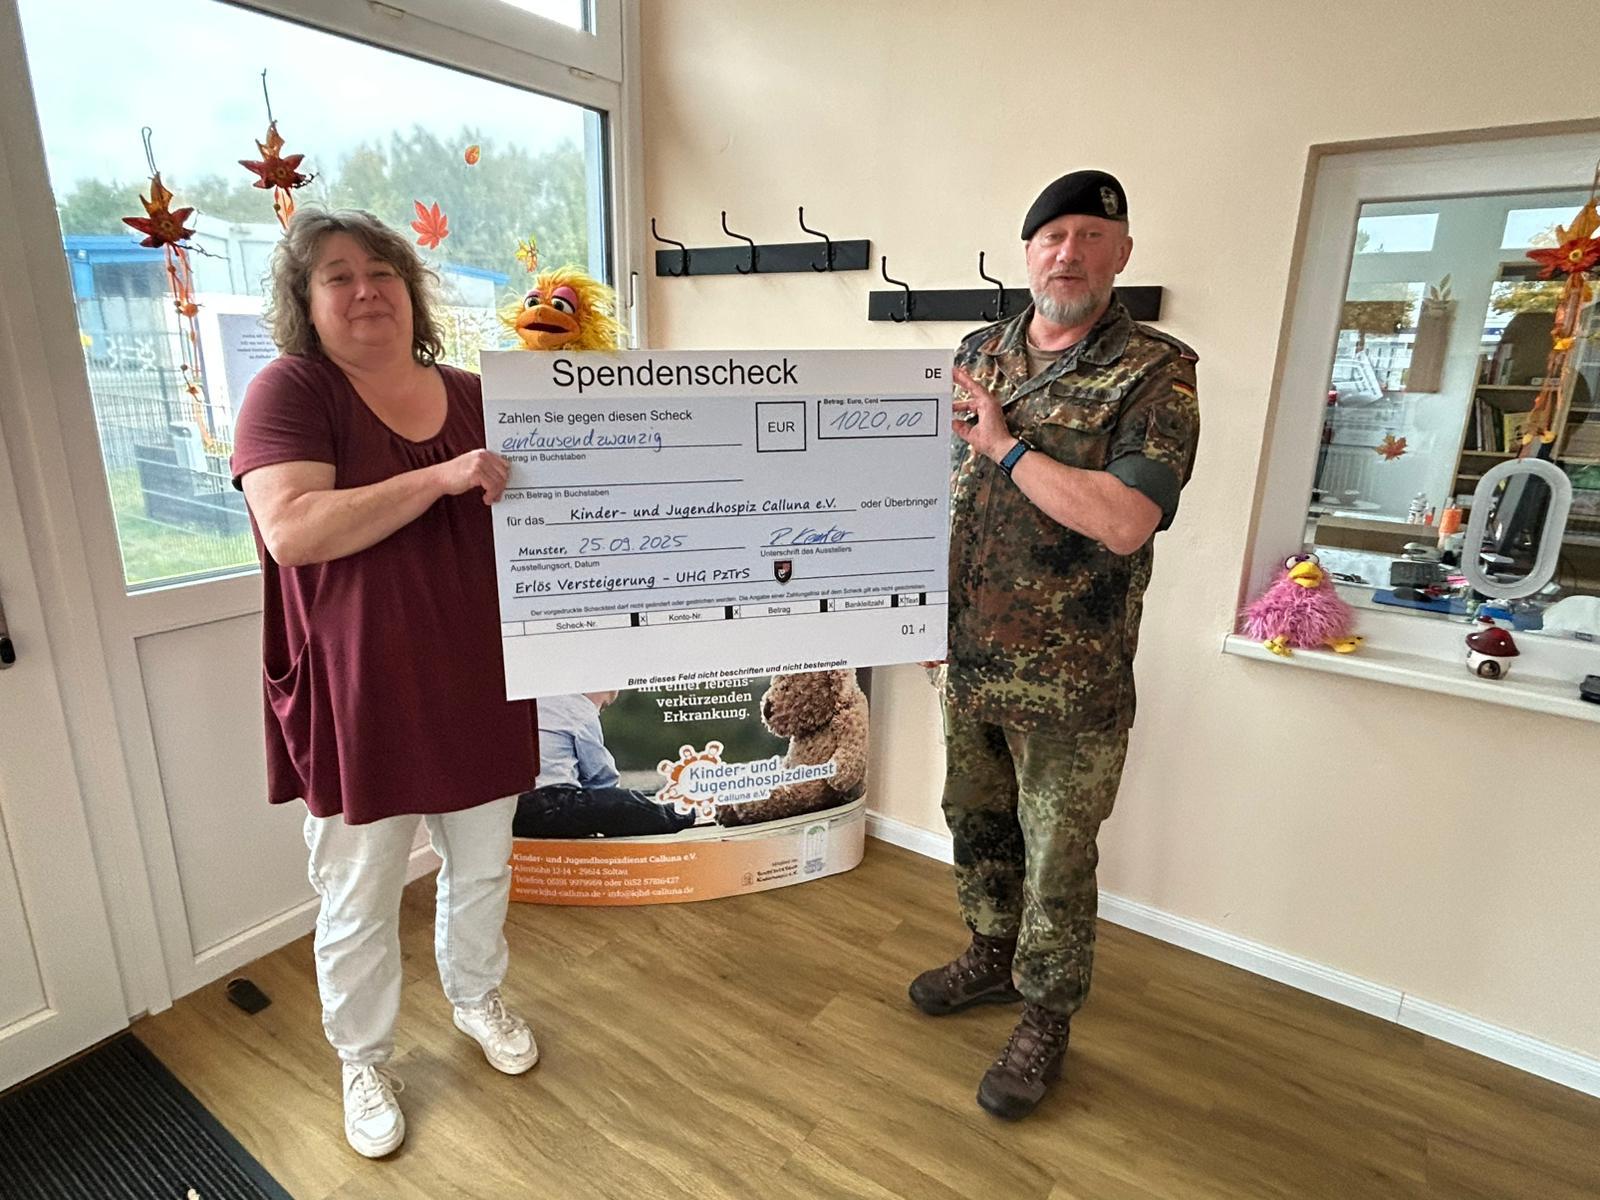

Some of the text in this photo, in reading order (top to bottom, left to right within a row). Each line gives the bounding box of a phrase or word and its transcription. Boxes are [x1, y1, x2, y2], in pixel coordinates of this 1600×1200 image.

[553, 358, 798, 393] Spendenscheck
[925, 368, 942, 379] DE
[499, 410, 692, 425] Zahlen Sie gegen diesen Scheck
[830, 410, 922, 430] 1020,00
[768, 422, 795, 432] EUR
[531, 453, 538, 461] in
[540, 452, 586, 461] Buchstaben
[526, 491, 552, 499] Betrag
[564, 488, 610, 497] Buchstaben
[507, 497, 938, 526] für das Kinder- und Jugendhospiz Calluna e.V. oder Überbringer
[518, 535, 688, 557] Munster, 25.09.2025
[760, 549, 800, 557] Unterschrift
[815, 546, 852, 554] Ausstellers
[574, 560, 600, 568] Datum
[516, 581, 551, 594] Erlös
[557, 576, 656, 592] Versteigerung
[676, 571, 706, 583] UHG
[713, 568, 750, 580] PzTrS
[768, 606, 791, 614] Betrag
[845, 600, 884, 608] Bankleitzahl
[902, 624, 914, 635] 01
[628, 659, 848, 686] Bitte dieses Feld nicht beschriften und nicht bestempeln
[656, 692, 752, 708] verkürzenden
[664, 707, 750, 723] Erkrankung.
[690, 760, 778, 780] Kinder- und
[690, 762, 834, 794] Jugendhospizdienst
[718, 793, 750, 802] Calluna
[546, 856, 562, 864] und
[564, 856, 648, 866] Jugendhospizdienst
[649, 854, 682, 864] Calluna
[604, 878, 622, 887] oder
